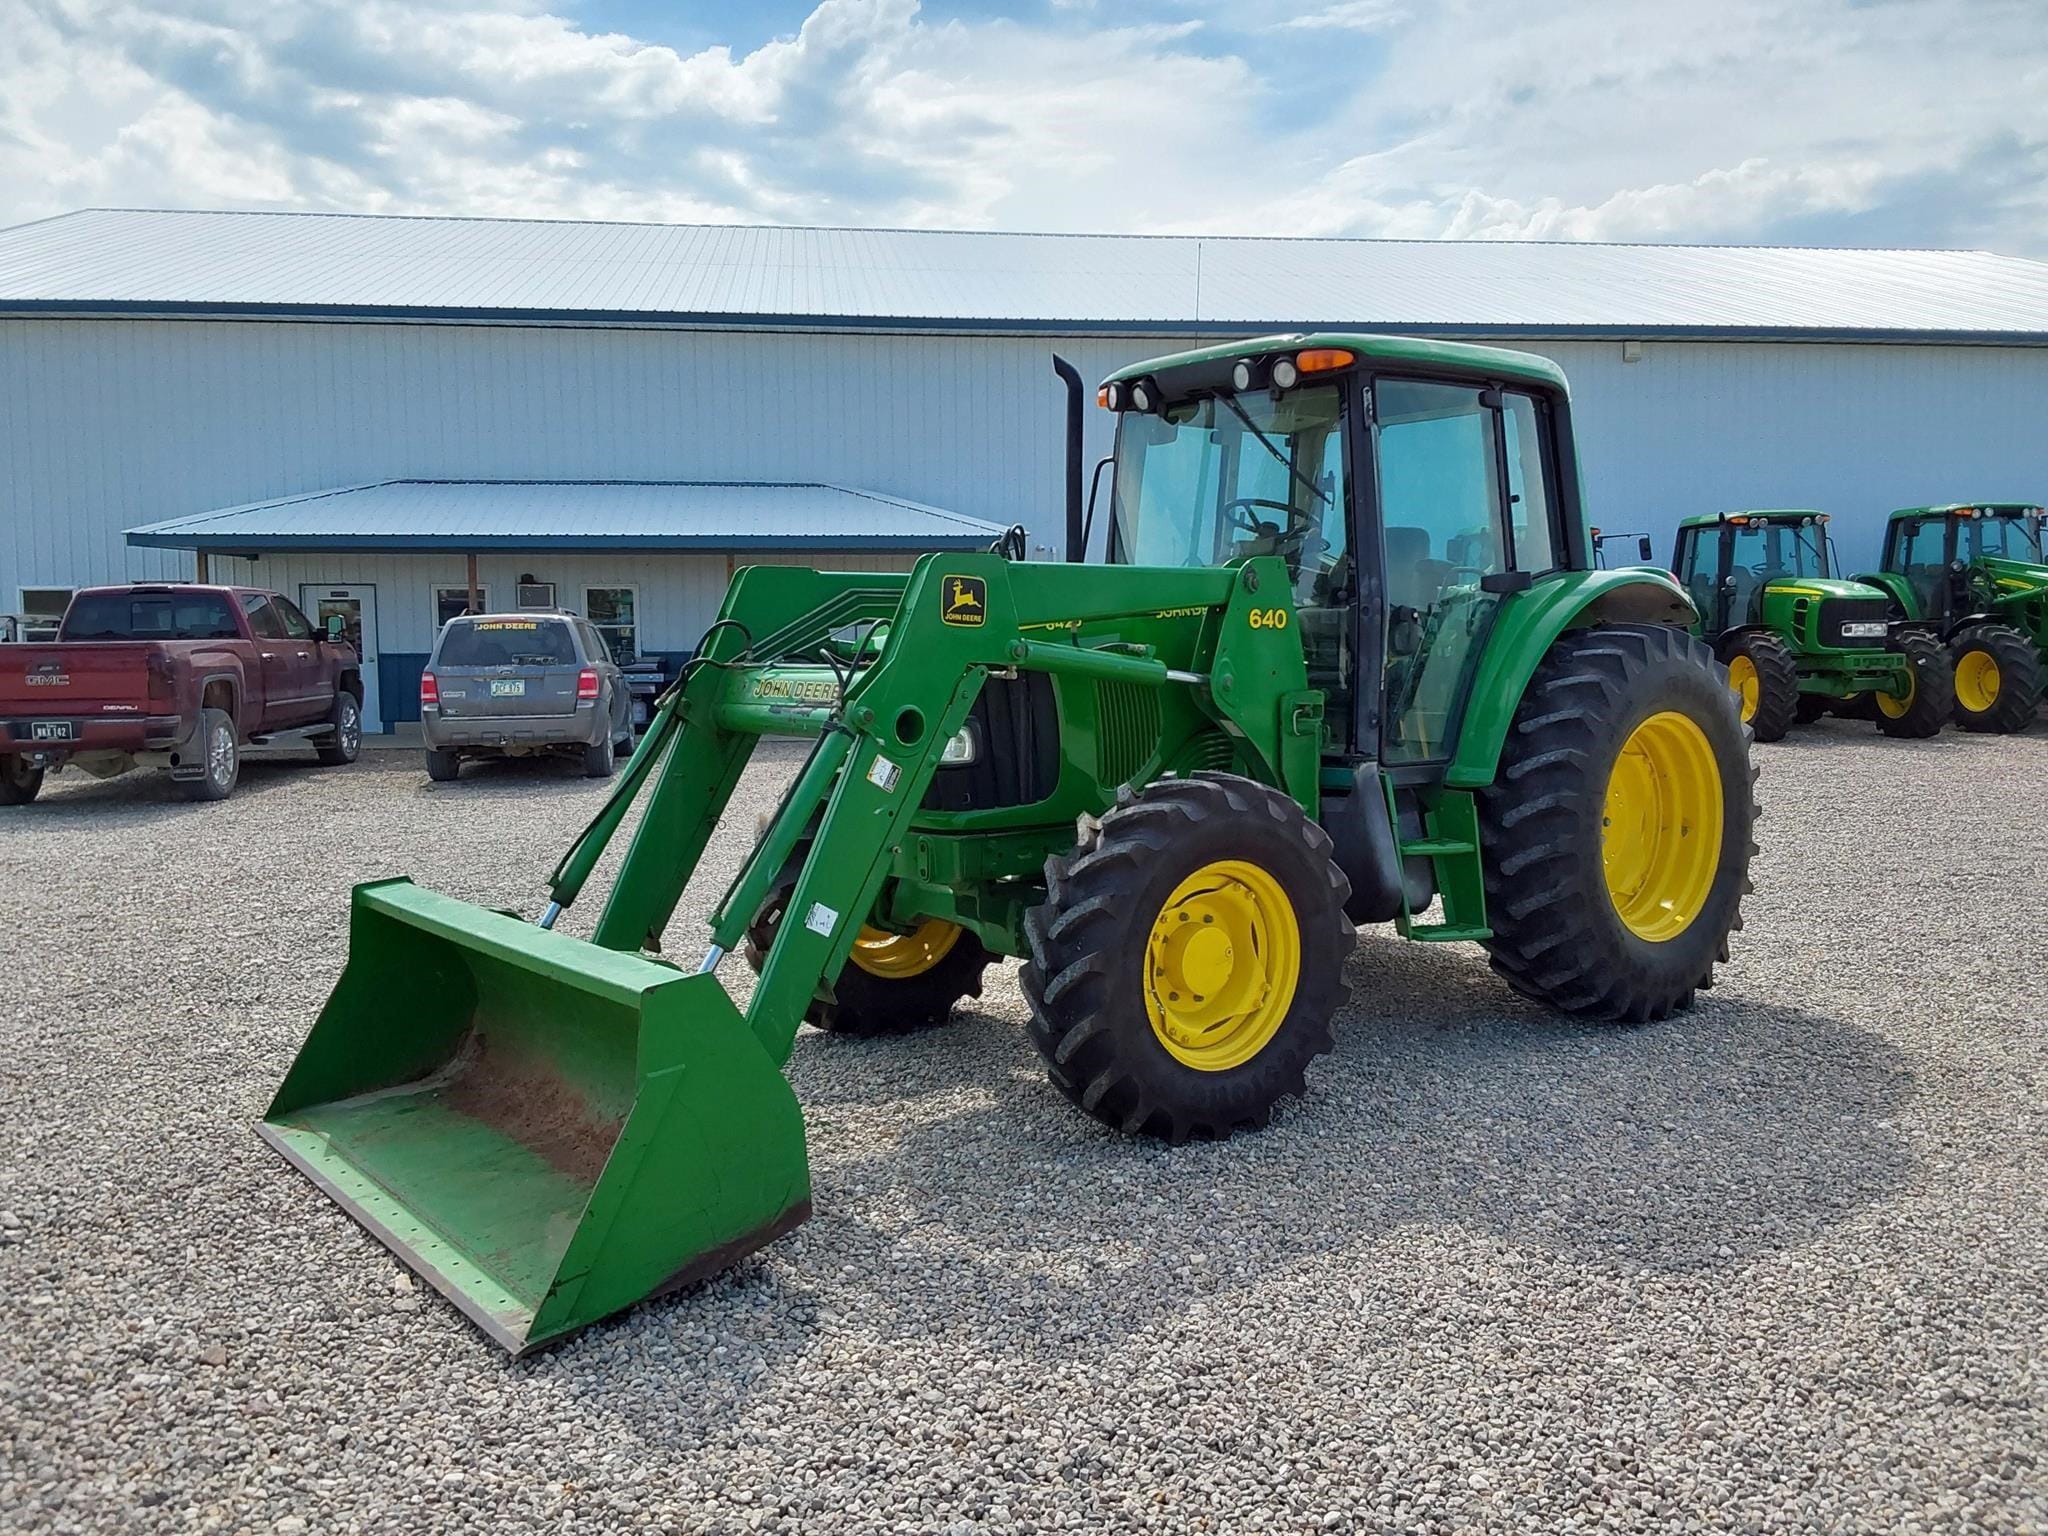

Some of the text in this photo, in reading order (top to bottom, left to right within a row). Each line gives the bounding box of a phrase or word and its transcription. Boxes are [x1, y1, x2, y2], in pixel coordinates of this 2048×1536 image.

[962, 614, 982, 622] DEERE
[1250, 608, 1287, 629] 640
[25, 674, 69, 686] GMC
[753, 679, 841, 699] JOHN DEERE
